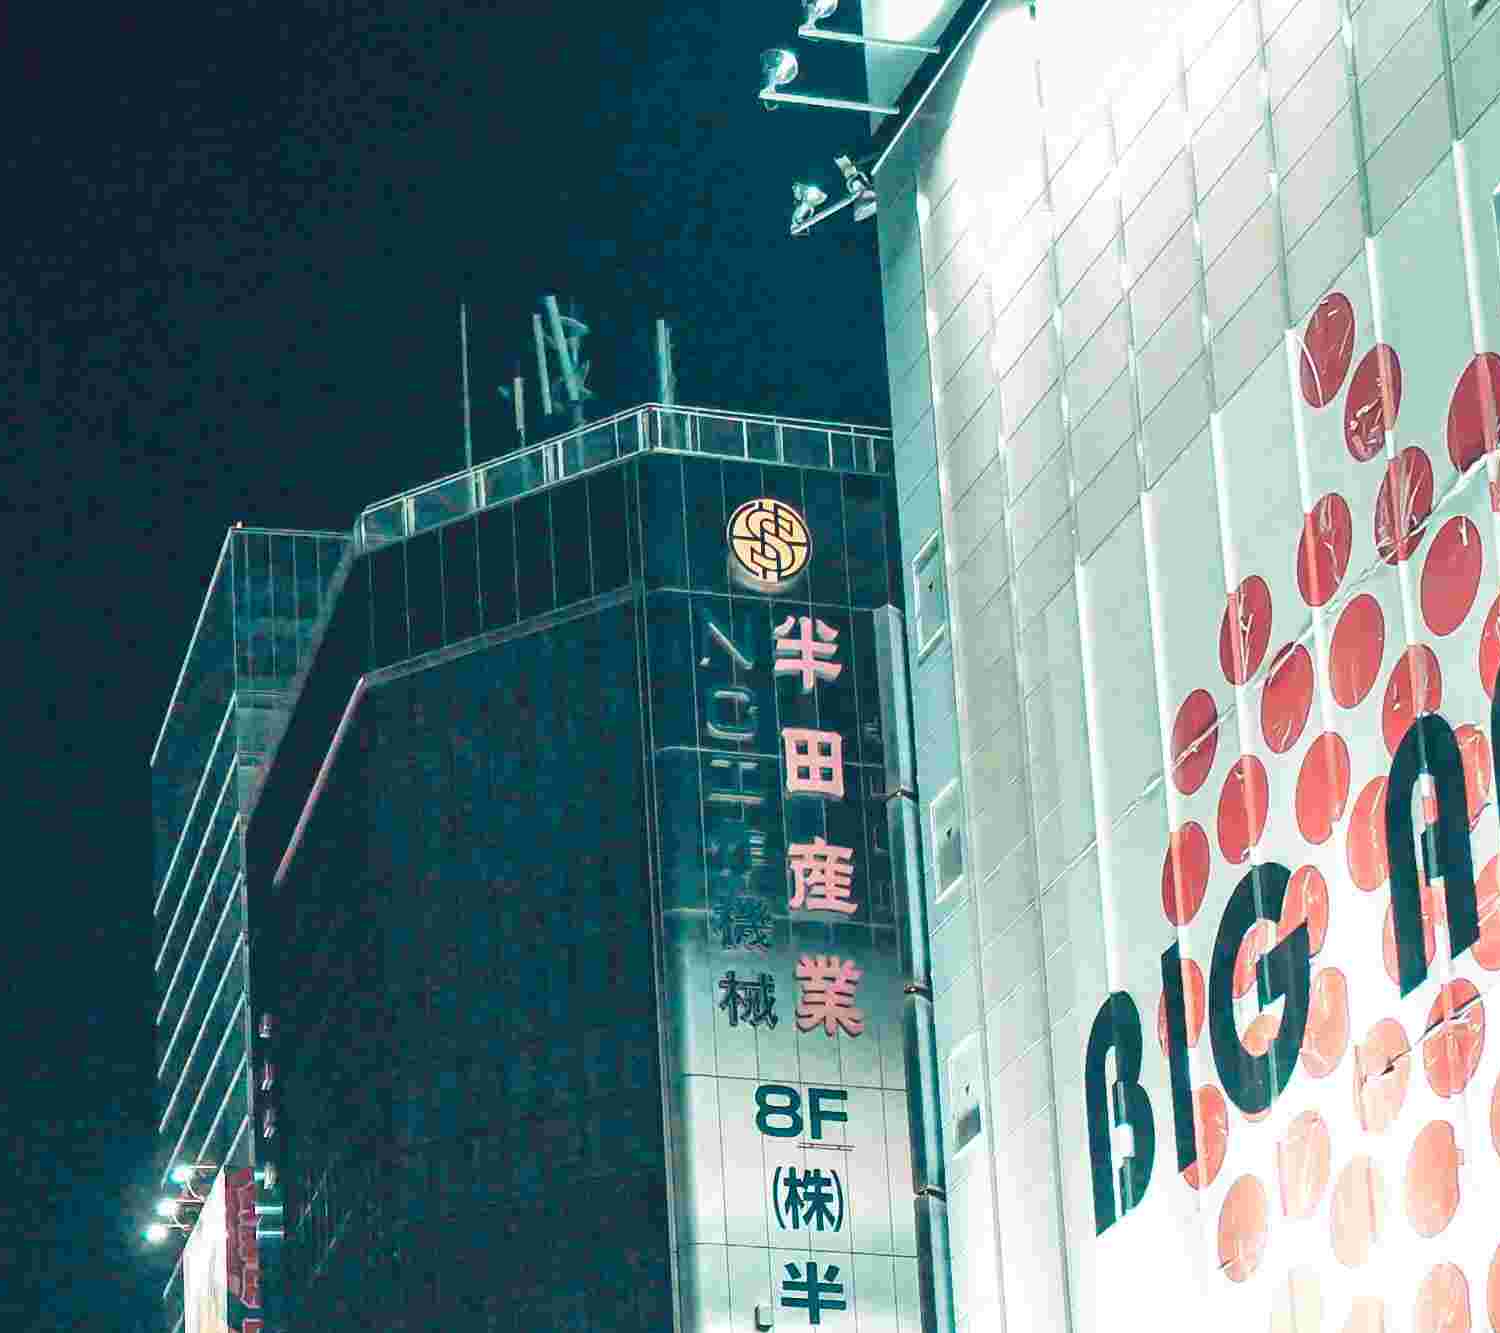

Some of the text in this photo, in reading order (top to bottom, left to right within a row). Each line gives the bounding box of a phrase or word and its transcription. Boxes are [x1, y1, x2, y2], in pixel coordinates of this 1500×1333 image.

[772, 615, 864, 1038] 半田産業
[755, 1084, 849, 1140] 8F
[1085, 861, 1311, 1237] BIG
